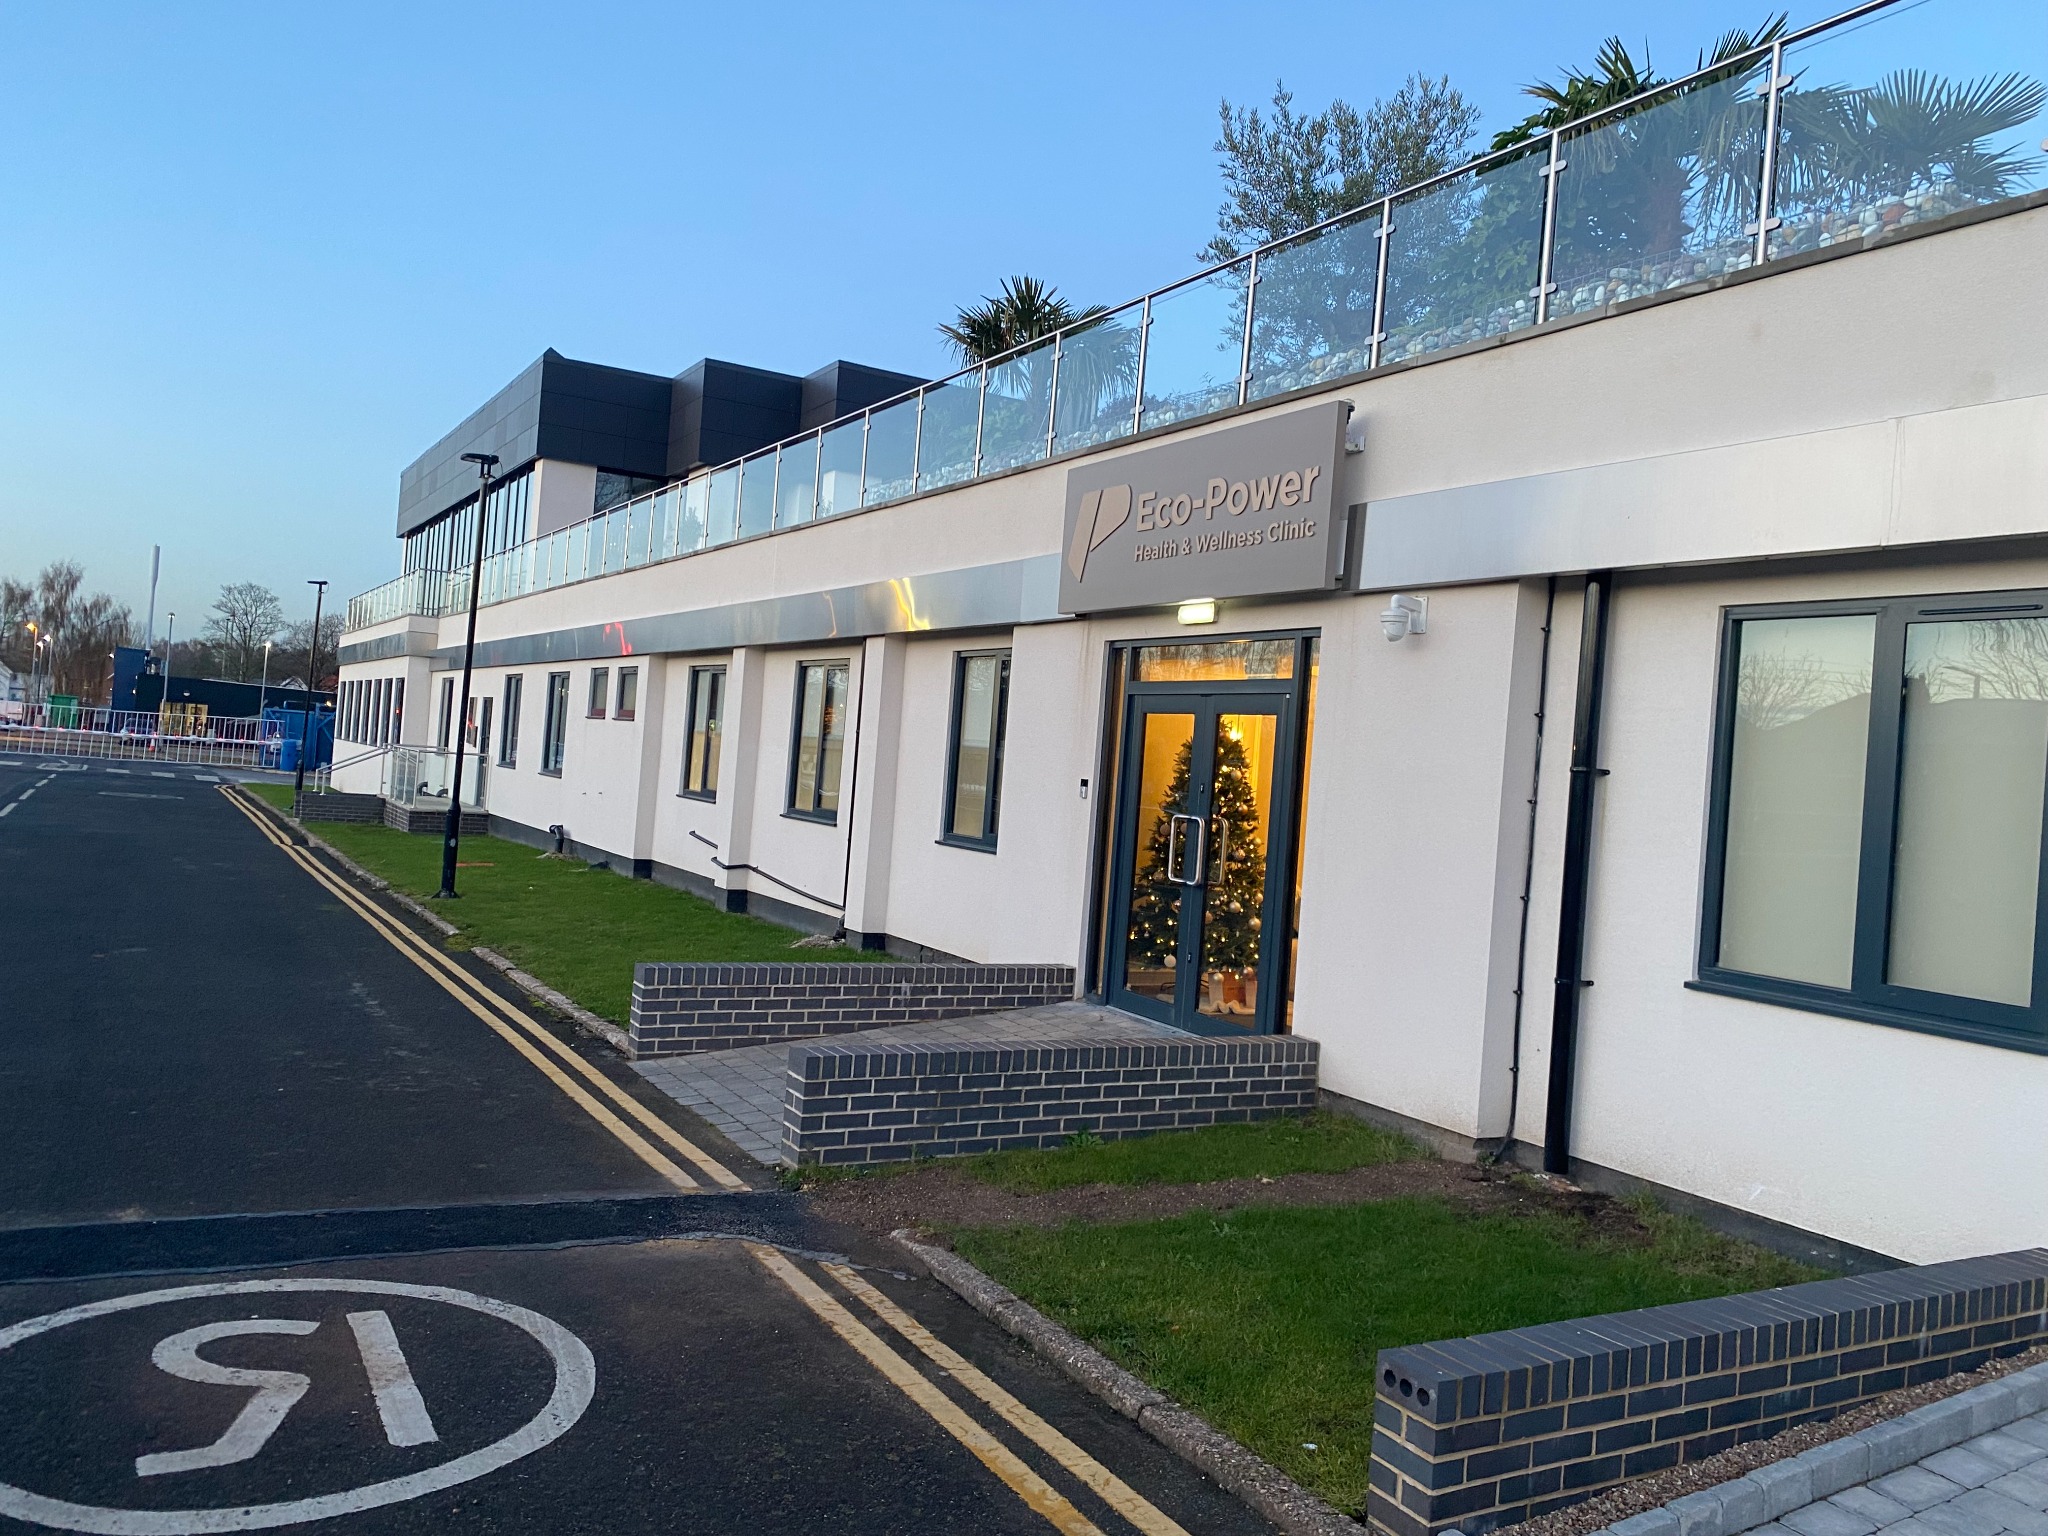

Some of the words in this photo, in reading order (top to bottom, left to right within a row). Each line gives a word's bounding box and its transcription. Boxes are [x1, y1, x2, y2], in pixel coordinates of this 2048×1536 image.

[1136, 466, 1320, 532] Eco-Power
[1134, 539, 1178, 562] Health
[1181, 537, 1191, 555] &
[1196, 530, 1263, 553] Wellness
[1267, 518, 1316, 542] Clinic
